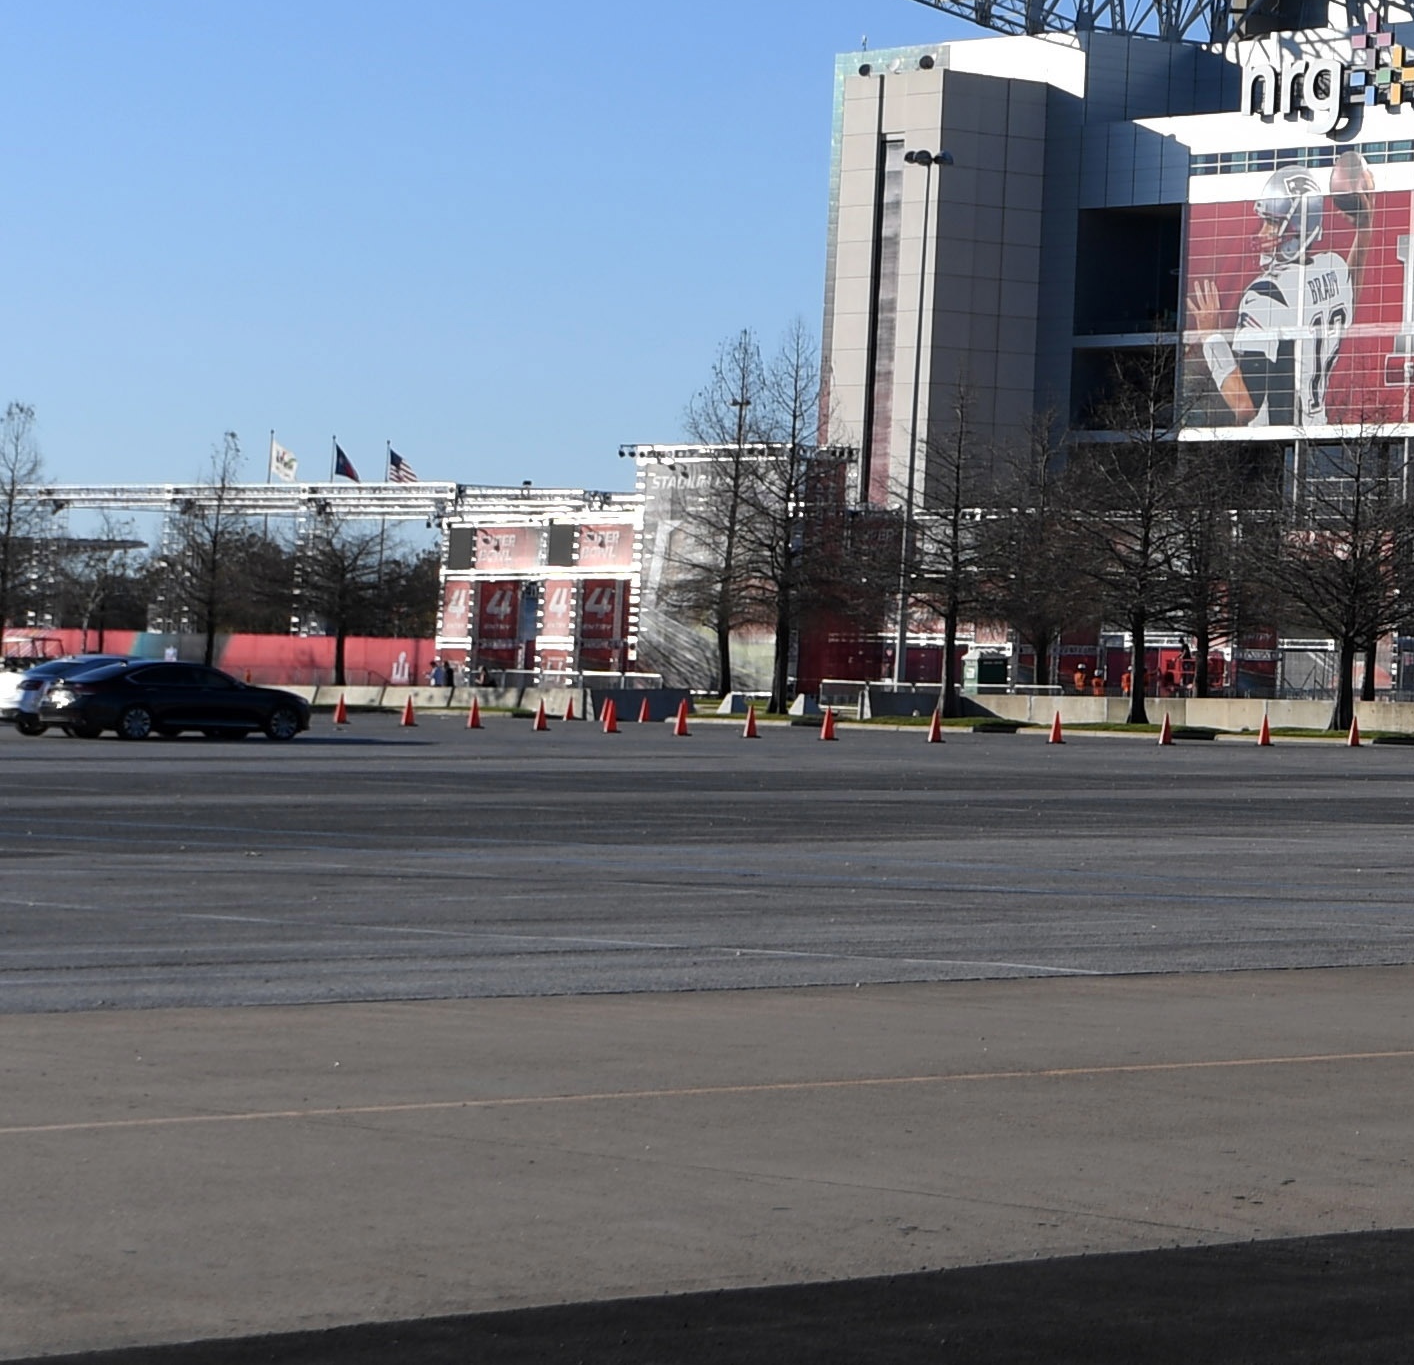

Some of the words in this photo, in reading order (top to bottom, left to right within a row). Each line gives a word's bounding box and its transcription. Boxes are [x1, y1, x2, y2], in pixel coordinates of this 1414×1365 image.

[1241, 57, 1344, 135] nrg
[1307, 271, 1339, 304] BRADY
[478, 549, 512, 562] BOWL
[580, 547, 616, 559] BOWL
[448, 589, 467, 618] 4
[486, 589, 513, 620] 4
[549, 587, 568, 617] 4
[585, 587, 613, 619] 4
